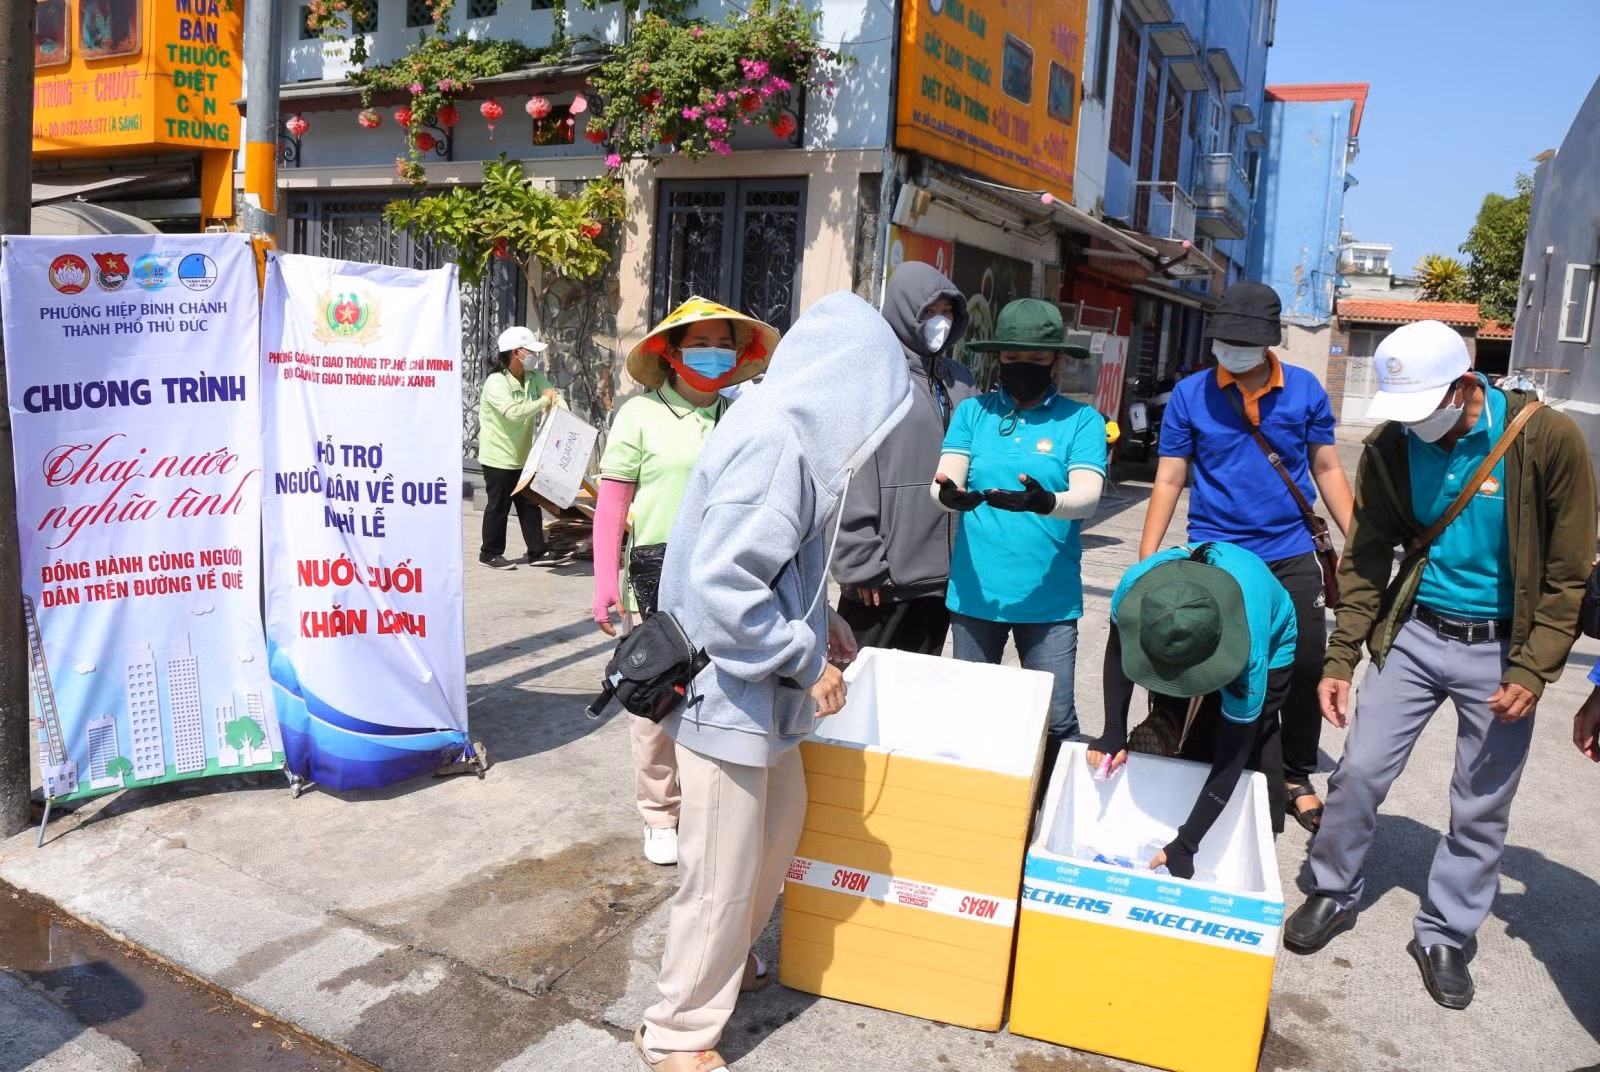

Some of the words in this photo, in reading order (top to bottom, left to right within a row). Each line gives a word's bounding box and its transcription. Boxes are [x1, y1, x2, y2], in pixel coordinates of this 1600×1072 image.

[166, 44, 231, 68] THUỐC
[165, 116, 229, 142] TRÙNG
[40, 302, 101, 320] PHƯỜNG
[106, 301, 137, 319] HIỆP
[140, 300, 174, 316] BÌNH
[179, 299, 228, 314] CHÁNH
[62, 321, 110, 338] THÀNH
[114, 316, 144, 335] PHỐ
[147, 316, 175, 333] THỦ
[179, 317, 209, 332] ĐỨC
[322, 355, 343, 368] GIAO
[345, 354, 377, 369] THÔNG
[426, 358, 453, 372] MINH
[23, 378, 152, 413] CHƯƠNG
[162, 370, 246, 404] TRÌNH
[322, 372, 343, 385] GIAO
[345, 371, 376, 387] THÔNG
[407, 376, 435, 388] XANH
[149, 447, 239, 478] nước
[317, 434, 335, 466] HỖ
[340, 443, 383, 474] TRỢ
[559, 431, 579, 472] AQUAFINA
[275, 465, 322, 494] NGƯỜ
[326, 473, 360, 502] DÂN
[366, 473, 394, 503] VỀ
[401, 477, 447, 507] QUÊ
[37, 474, 161, 550] nghĩa
[167, 469, 261, 518] tình
[324, 506, 355, 535] NHỈ
[361, 507, 386, 538] LỄ
[41, 559, 91, 584] ĐỒNG
[95, 555, 143, 577] HÀNH
[148, 551, 195, 572] CÙNG
[200, 546, 242, 567] NGƯỜI
[42, 586, 80, 609] DÂN
[84, 579, 129, 601] TRÊN
[133, 574, 192, 597] ĐƯỜNG
[196, 567, 217, 590] VỀ
[222, 570, 243, 590] QUÊ
[300, 604, 367, 638] KHĂN
[832, 869, 871, 893] NBAS
[958, 895, 999, 919] NBAS
[1126, 906, 1264, 946] SKECHERS
